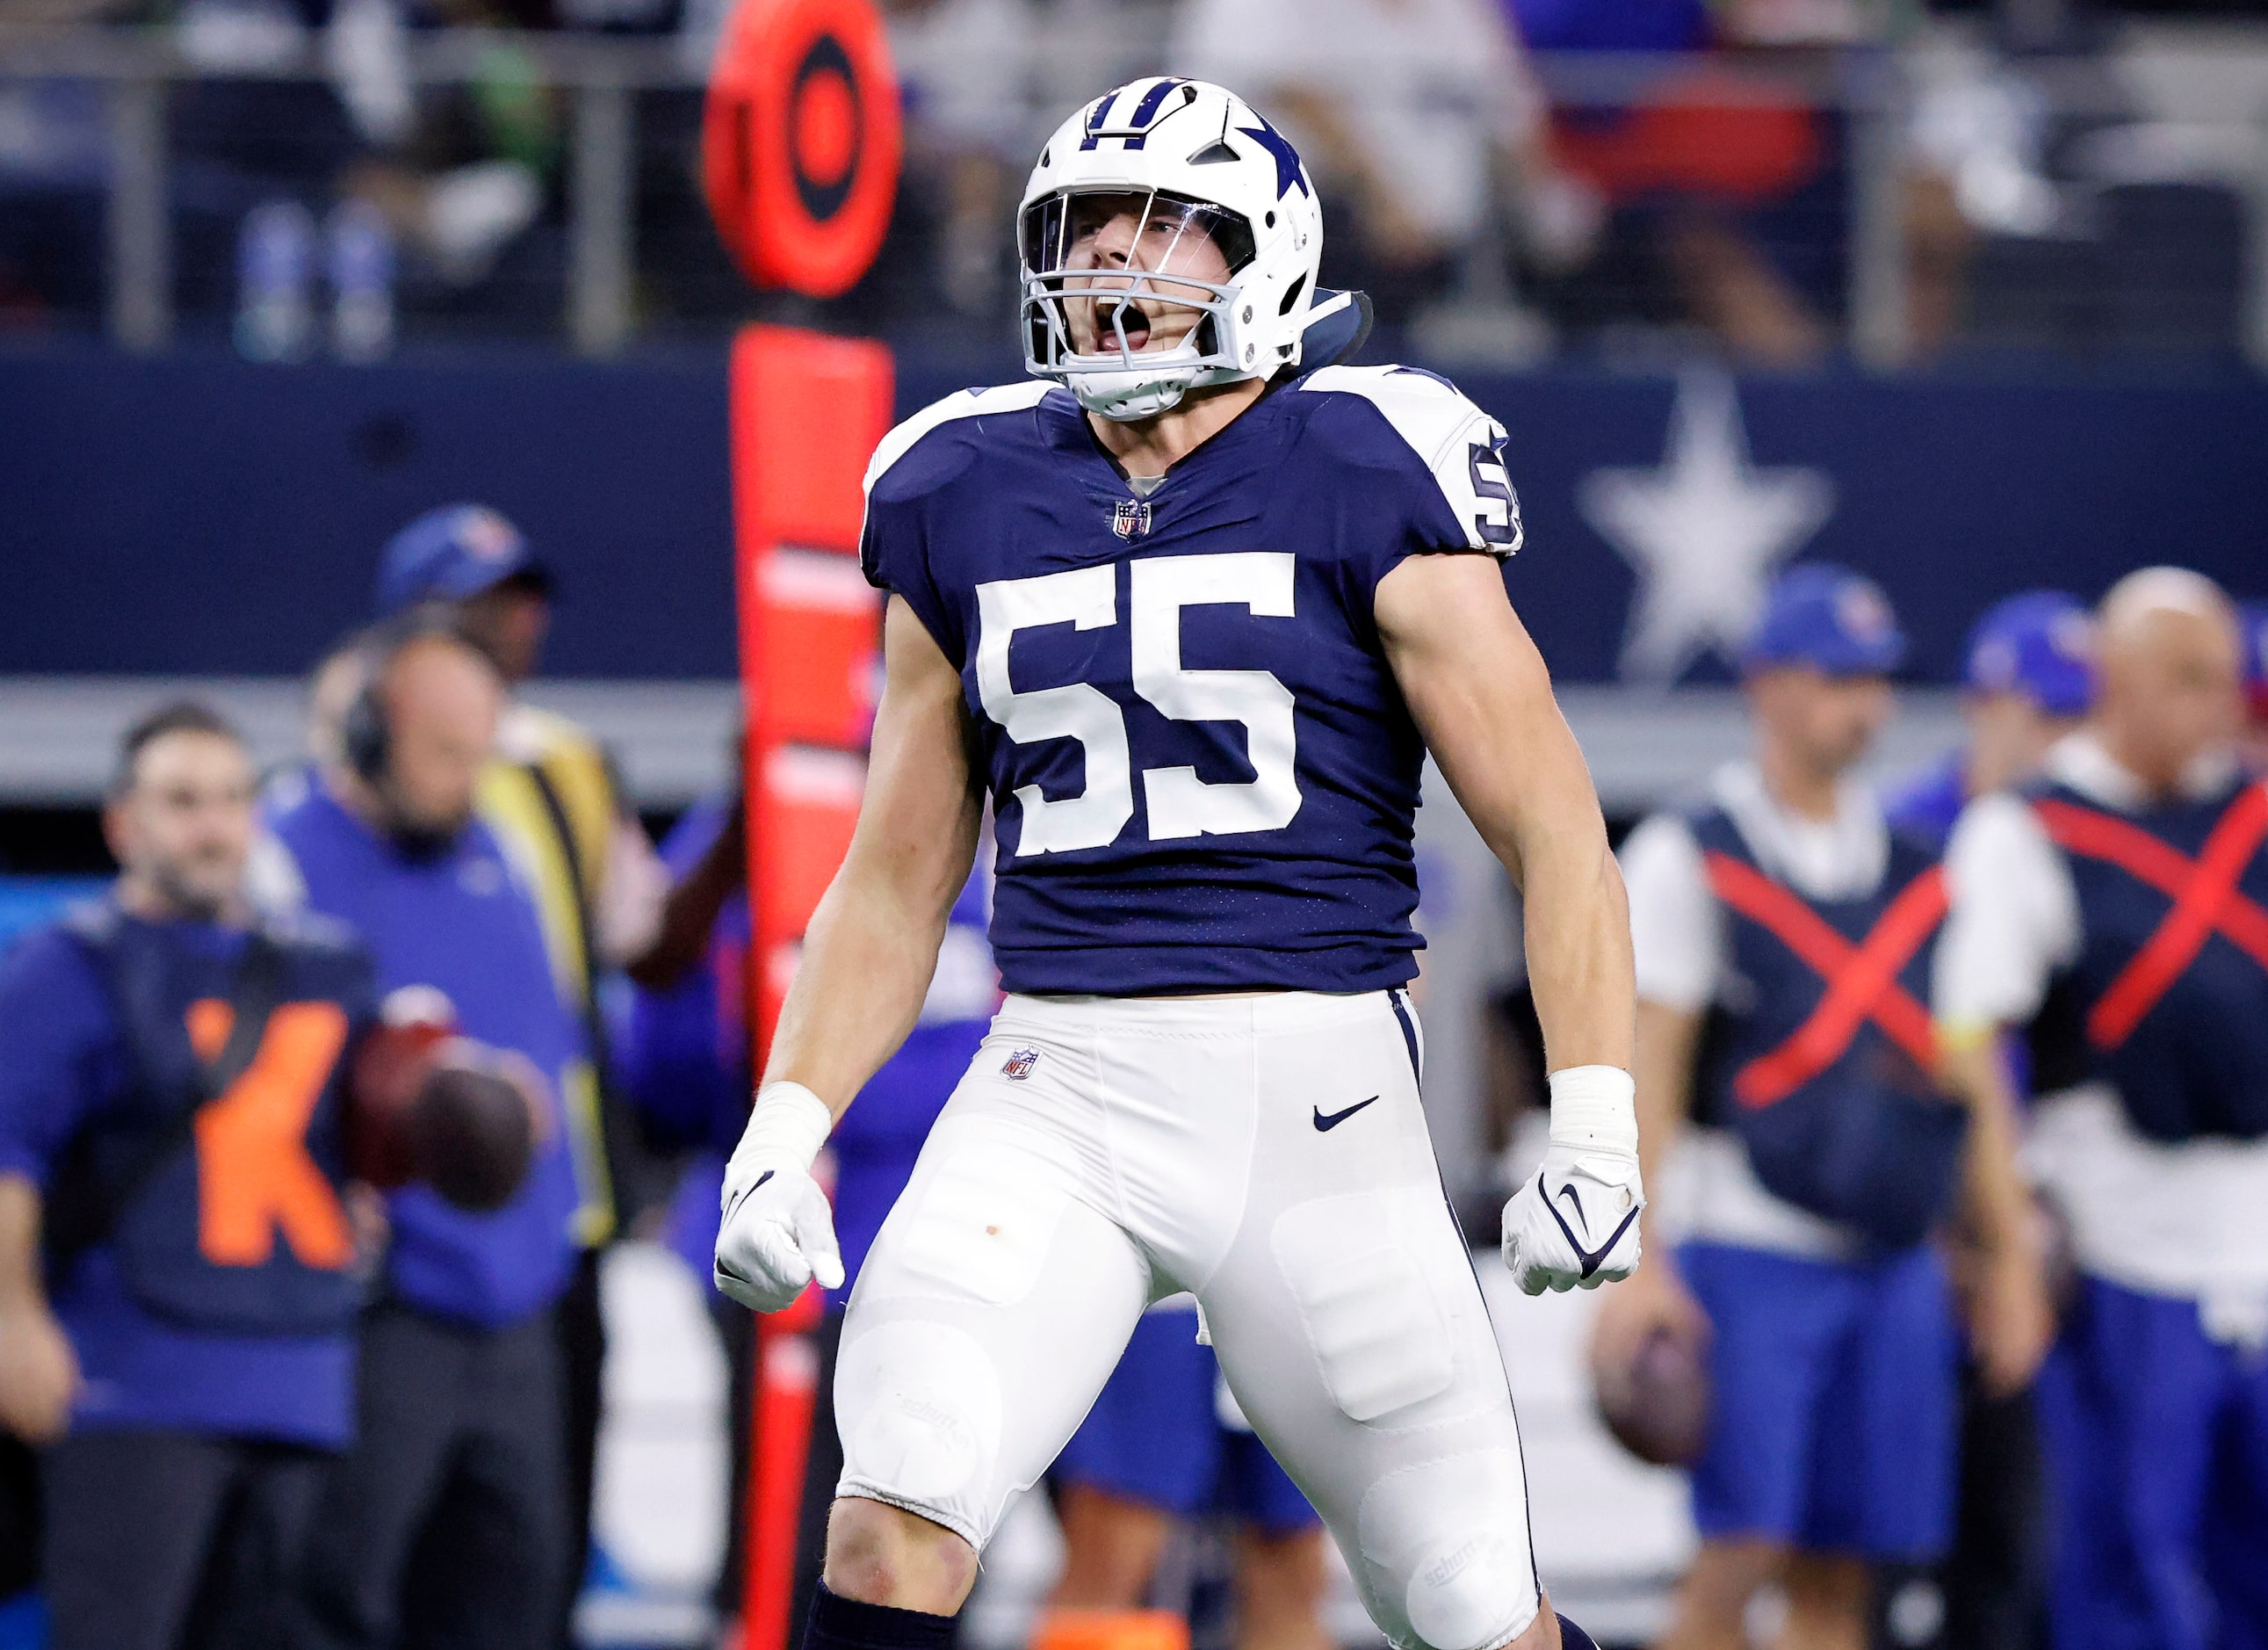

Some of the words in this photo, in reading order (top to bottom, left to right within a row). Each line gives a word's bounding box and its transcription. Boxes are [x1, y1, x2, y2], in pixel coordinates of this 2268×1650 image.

[975, 551, 1303, 857] 55
[185, 998, 355, 1270] K
[1006, 1061, 1028, 1075] NFL
